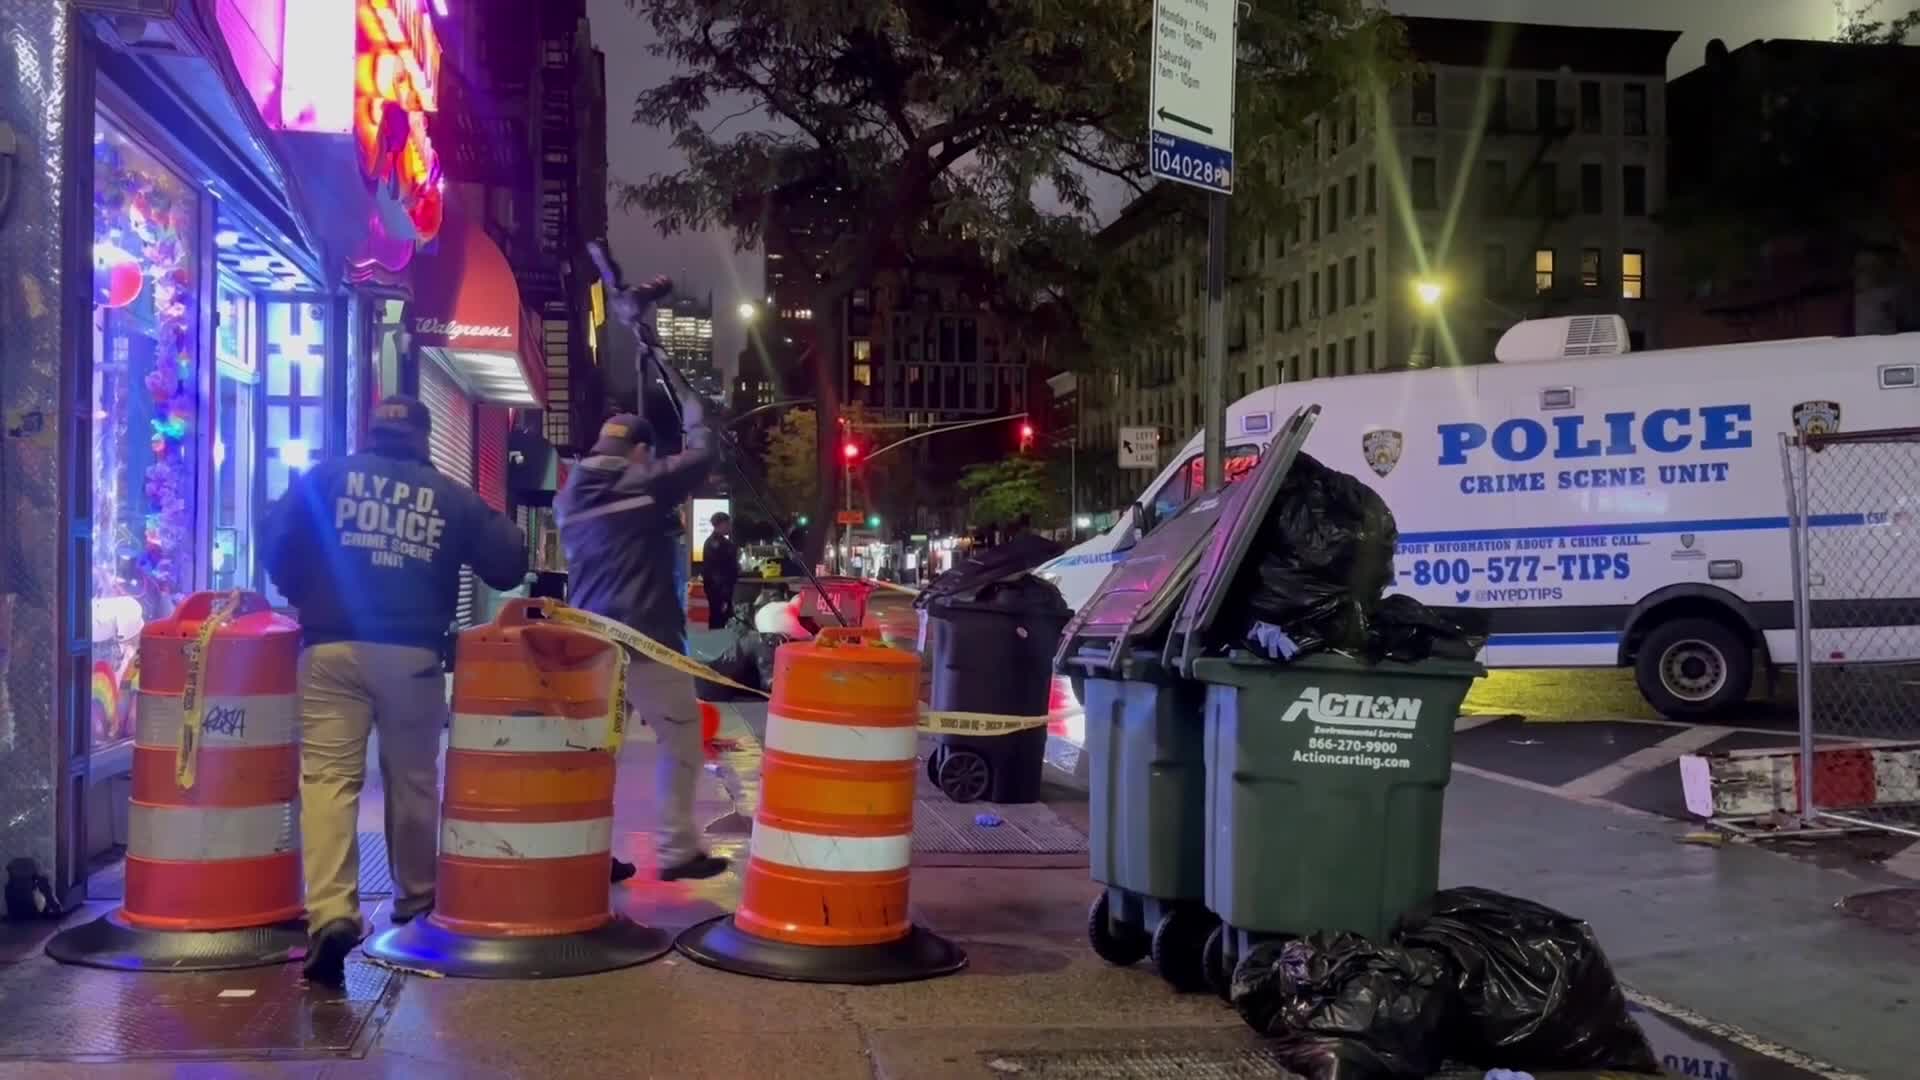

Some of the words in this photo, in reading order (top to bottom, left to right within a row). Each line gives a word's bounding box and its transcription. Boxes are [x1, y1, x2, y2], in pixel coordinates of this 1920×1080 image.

[1160, 5, 1188, 30] Monday
[1195, 20, 1217, 43] Friday
[1160, 23, 1177, 39] 4pm
[1183, 32, 1203, 50] 10pm
[1158, 45, 1192, 73] Saturday
[1158, 62, 1174, 80] 7am
[1180, 71, 1200, 90] 10pm
[416, 318, 512, 340] Walgreens
[1437, 404, 1753, 466] POLICE
[1460, 472, 1545, 495] CRIME
[1558, 466, 1646, 490] SCENE
[1658, 462, 1729, 485] UNIT
[346, 471, 439, 516] N.Y.P.D.
[336, 496, 446, 549] POLICE
[341, 530, 388, 549] CRIME
[391, 538, 434, 563] SCENE
[1434, 540, 1511, 553] INFORMATION
[1516, 538, 1554, 550] ABOUT
[1558, 539, 1566, 549] A
[1570, 536, 1607, 548] CRIME
[371, 550, 405, 569] UNIT
[1391, 552, 1630, 587] -800-577-TIPS
[1308, 736, 1398, 754] 866-270-9900
[1378, 730, 1413, 740] Services
[1292, 750, 1411, 770] Actioncarting.com
